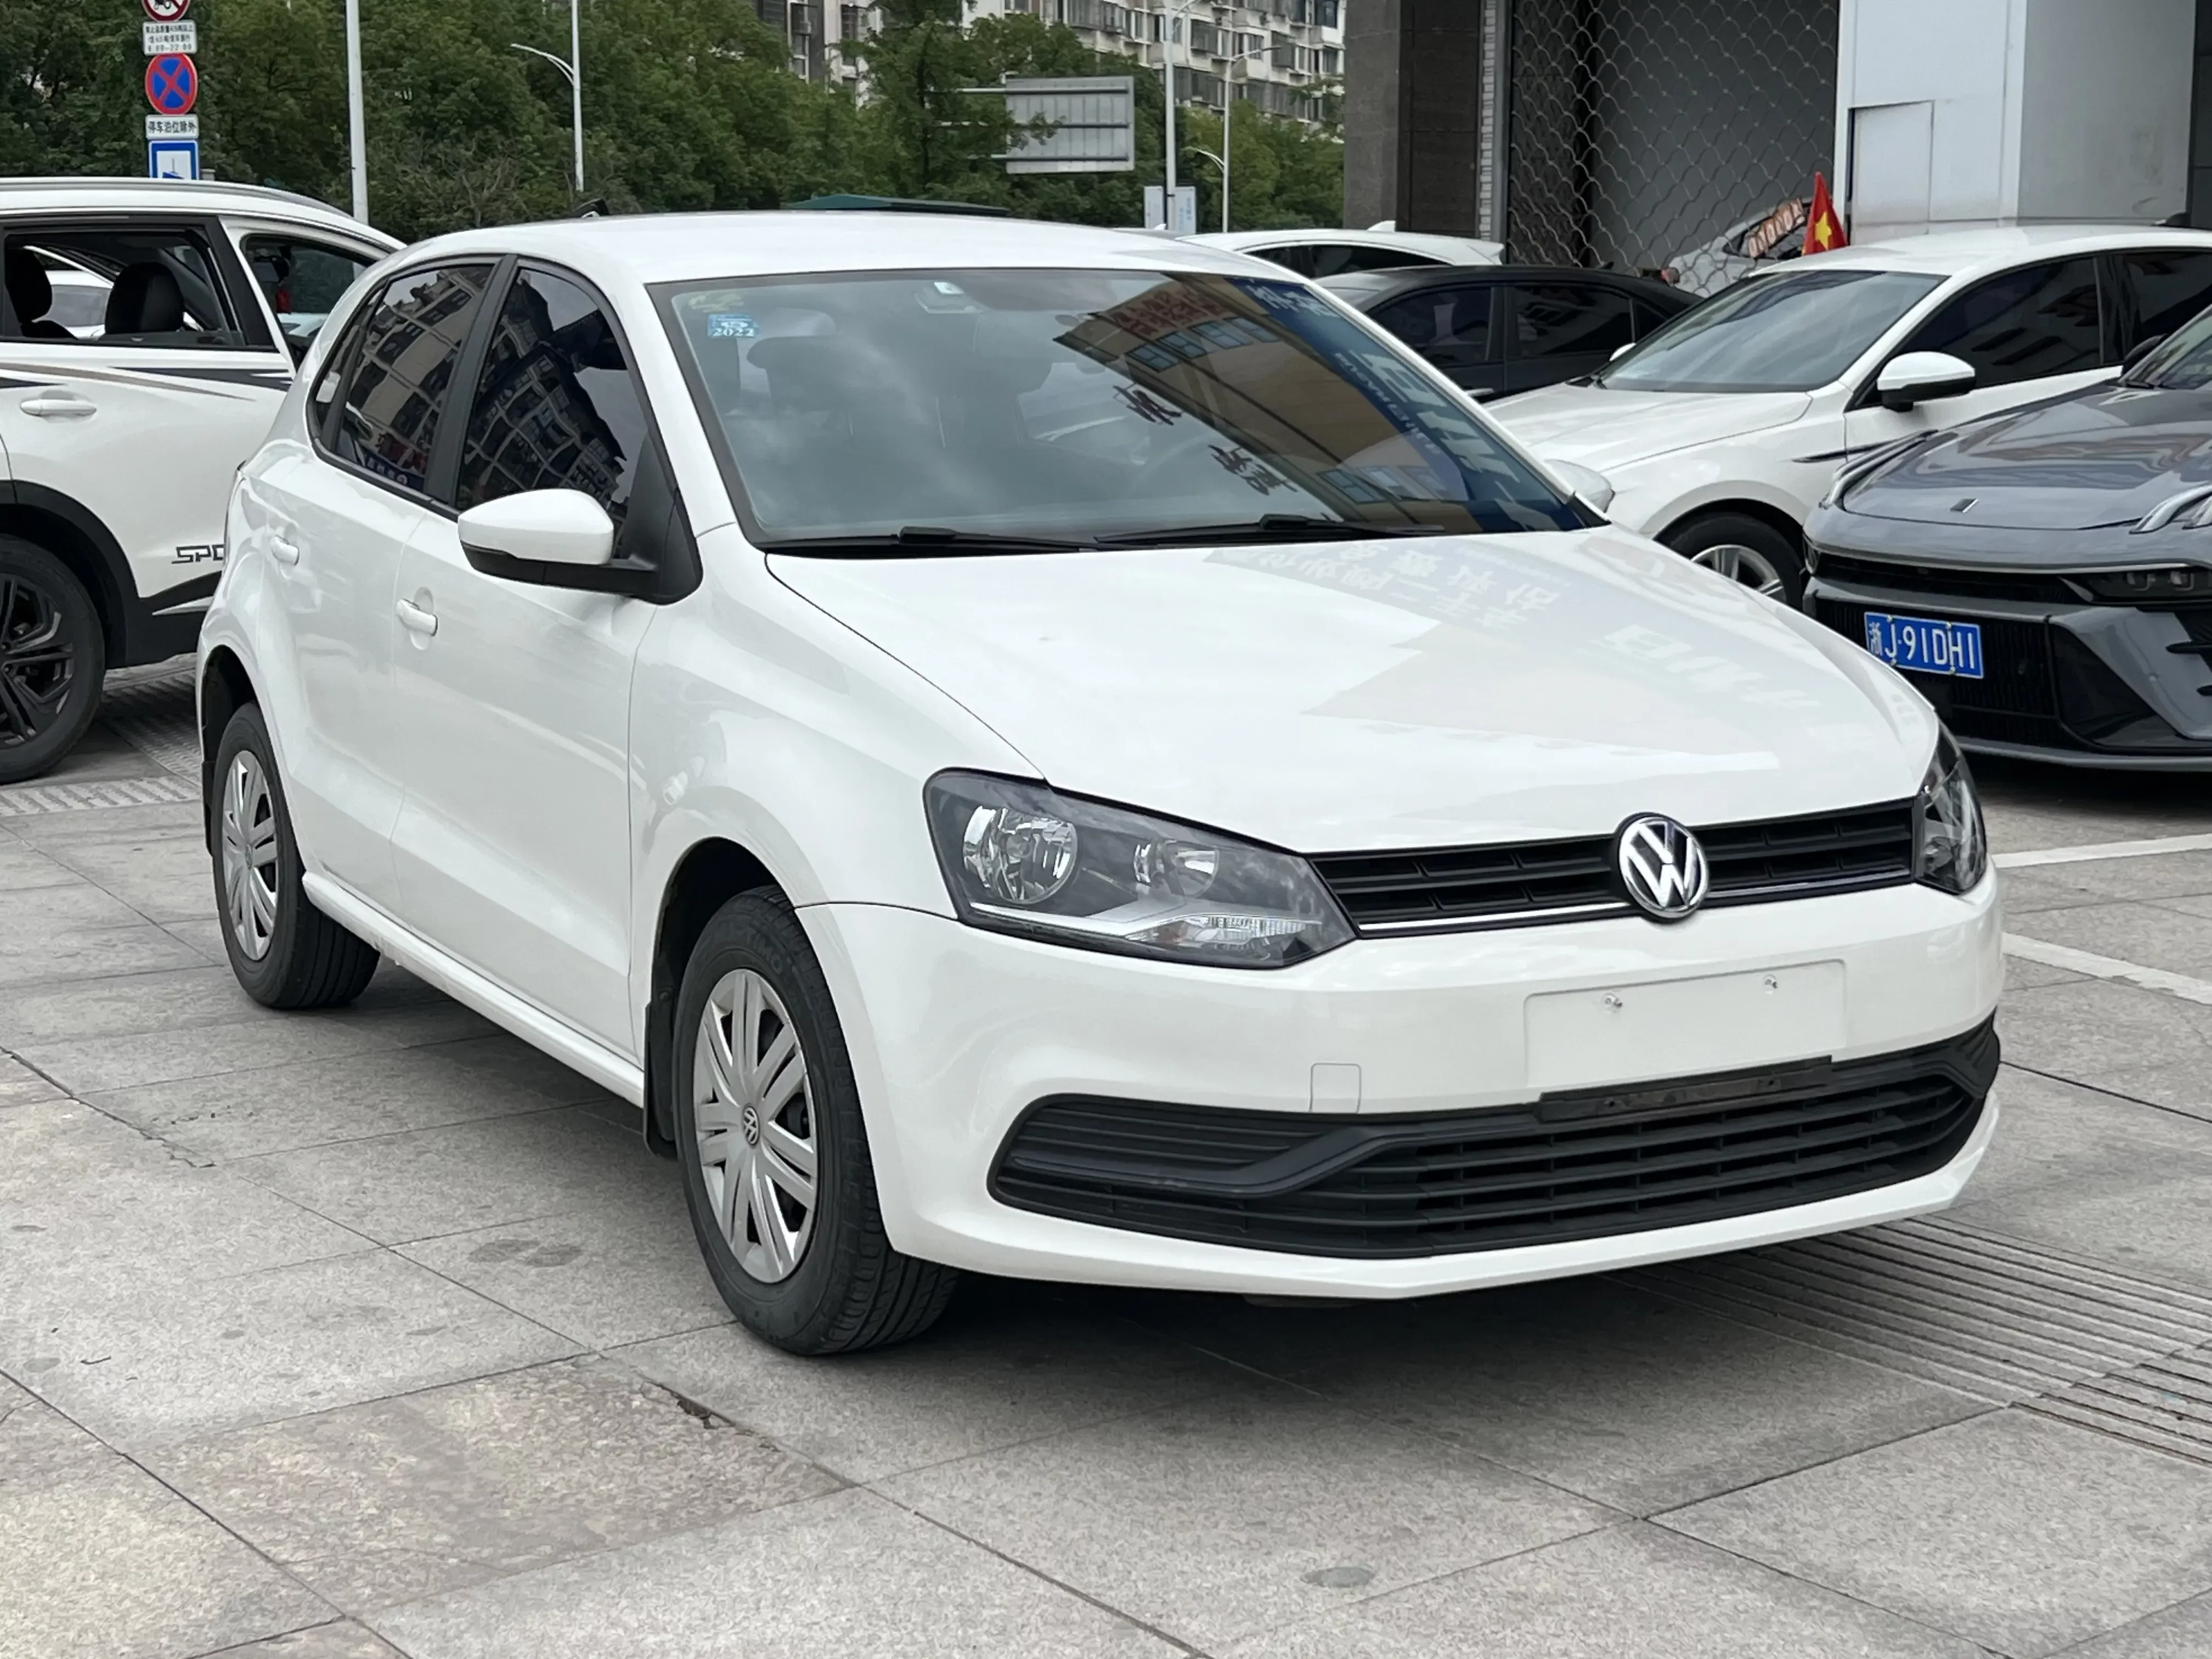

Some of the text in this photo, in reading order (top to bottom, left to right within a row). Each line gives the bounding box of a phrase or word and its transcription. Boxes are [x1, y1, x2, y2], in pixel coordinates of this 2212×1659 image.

[148, 121, 196, 133] 停车泊位除外
[713, 328, 754, 337] 2022
